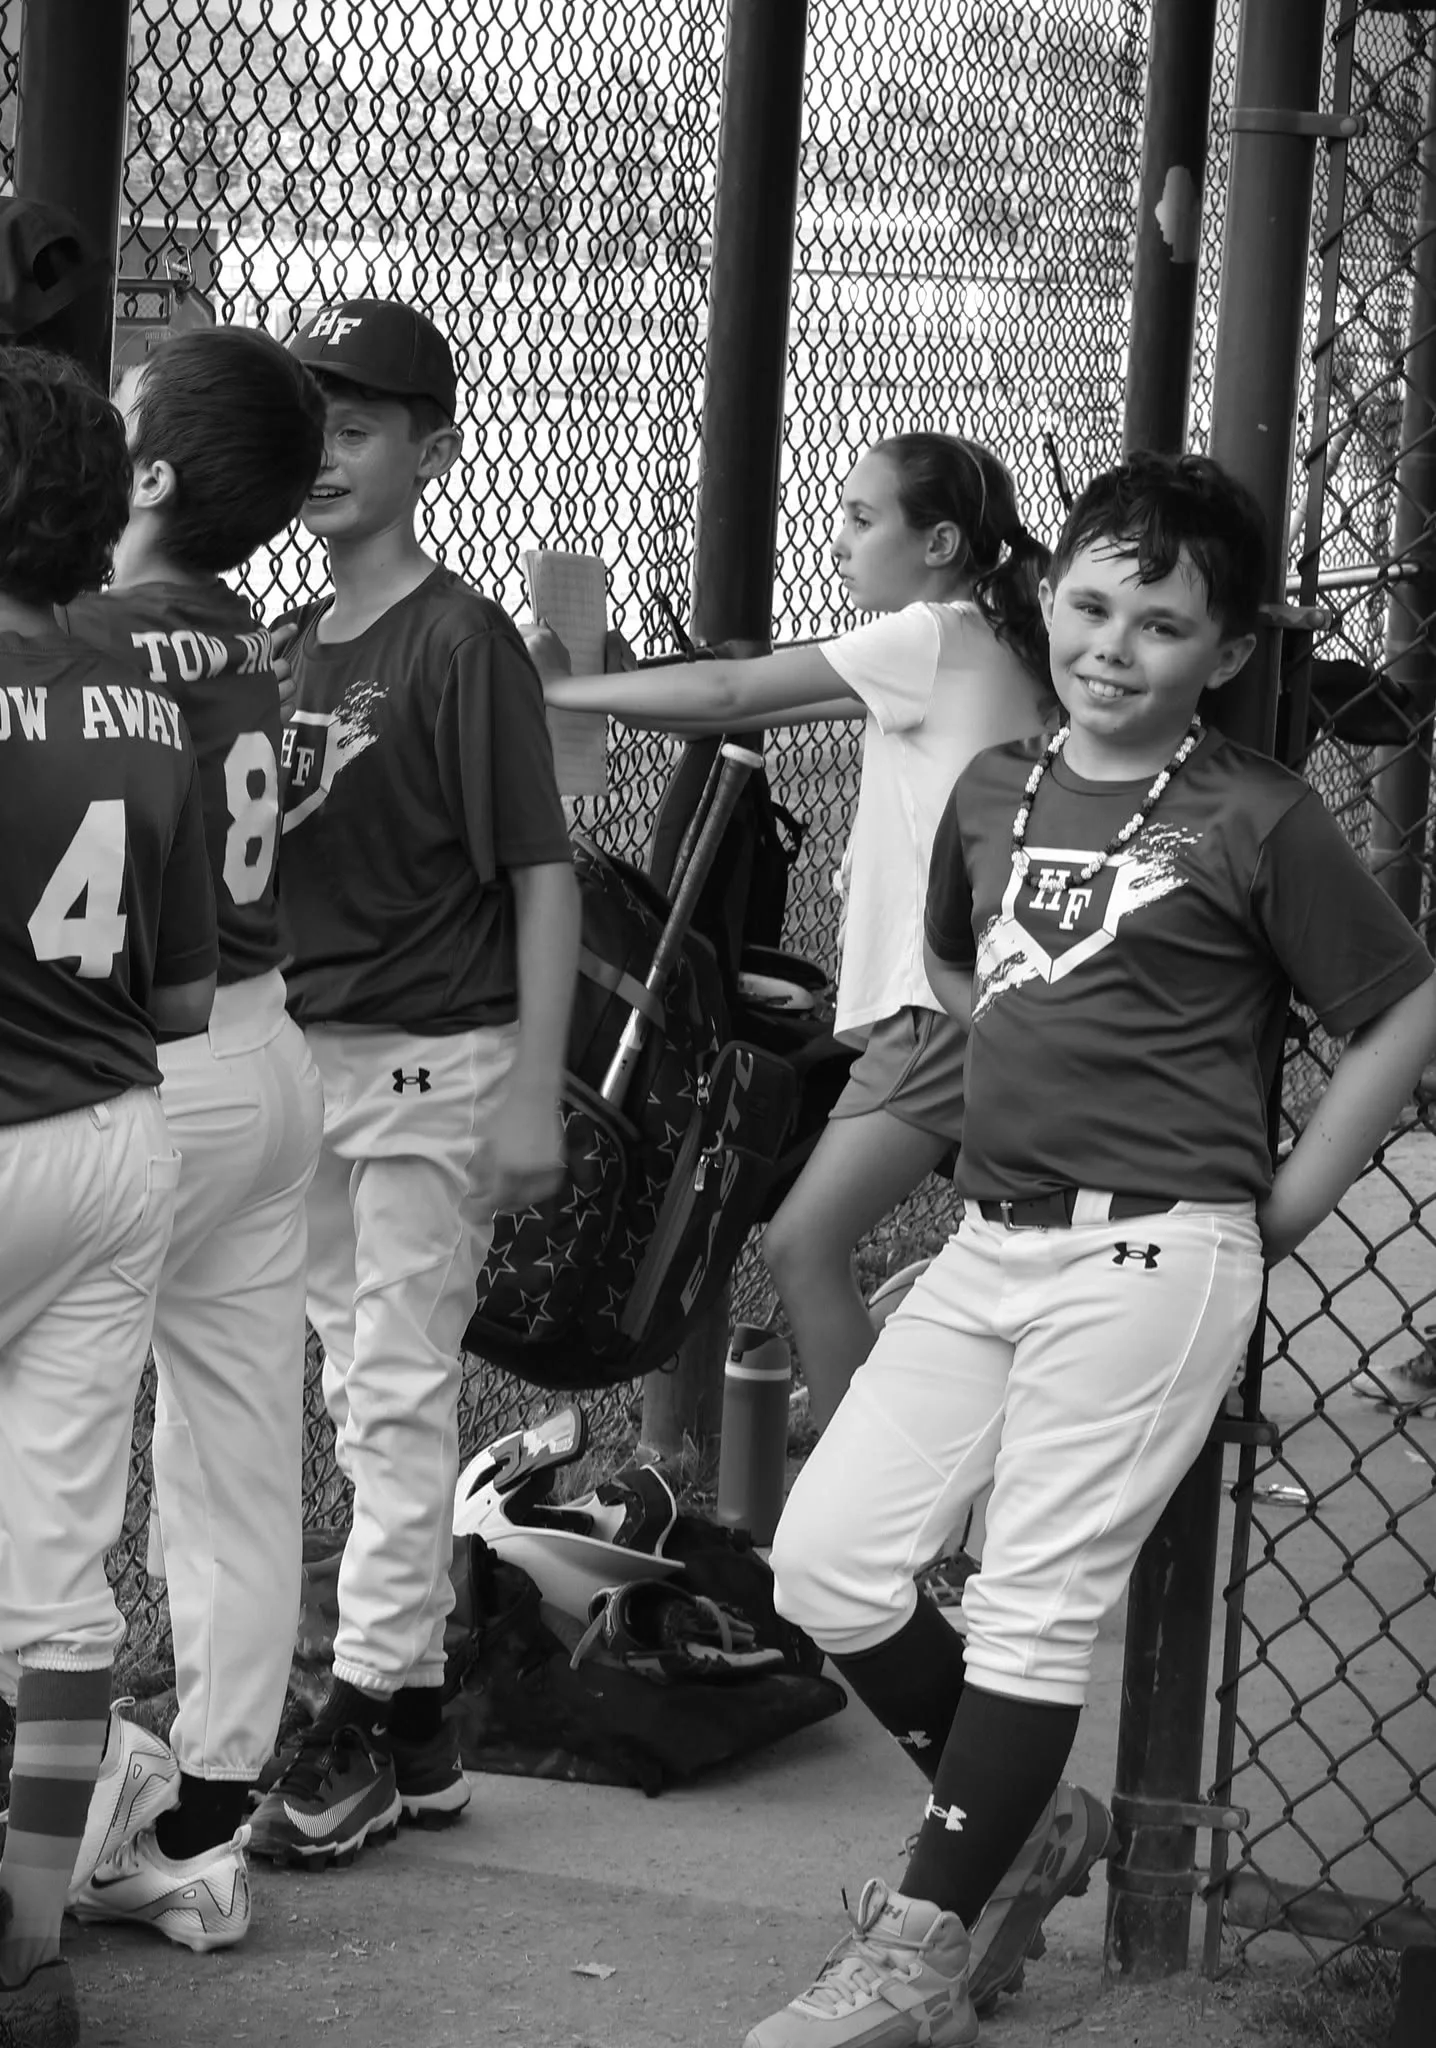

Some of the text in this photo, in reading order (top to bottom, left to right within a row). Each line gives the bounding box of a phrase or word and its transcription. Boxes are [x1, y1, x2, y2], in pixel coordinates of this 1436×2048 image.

[307, 308, 362, 345] HF
[131, 630, 228, 683] TOW
[82, 684, 182, 751] AWAY
[280, 728, 315, 786] HF
[222, 730, 278, 905] 8
[27, 799, 127, 979] 4
[1028, 867, 1093, 930] HF
